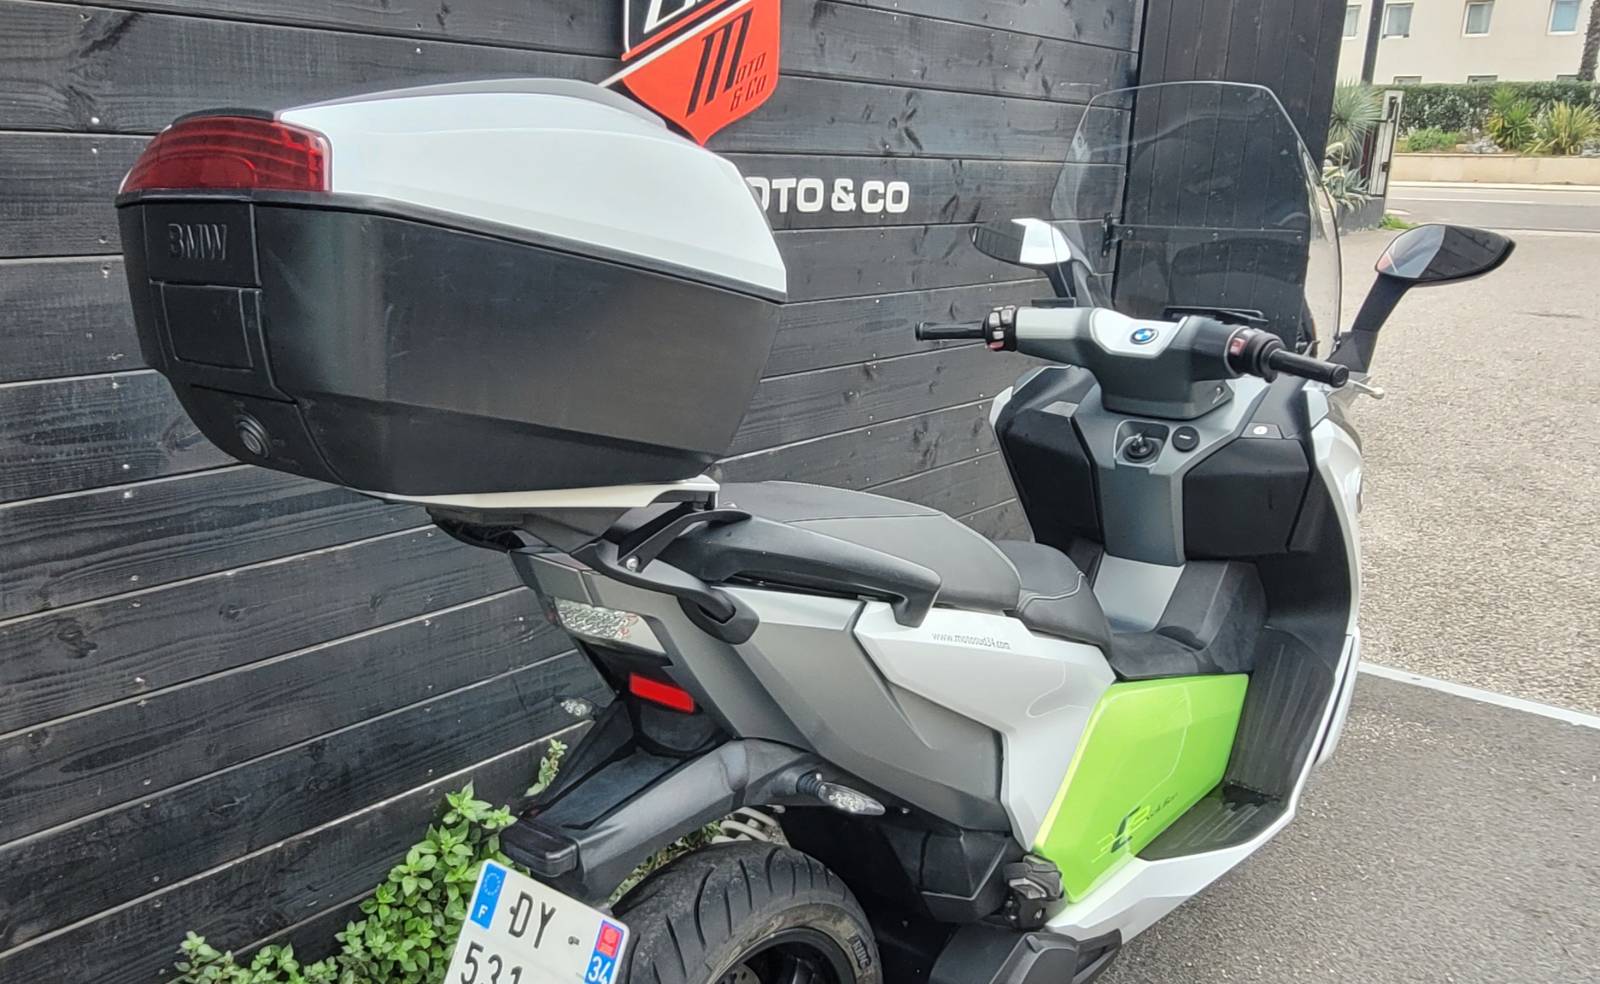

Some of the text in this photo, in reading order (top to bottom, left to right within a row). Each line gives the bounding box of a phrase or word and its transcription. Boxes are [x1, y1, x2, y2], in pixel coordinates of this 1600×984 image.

[745, 176, 910, 213] OTO & CO
[168, 223, 228, 260] BMW
[478, 903, 489, 920] F
[508, 890, 556, 949] DY
